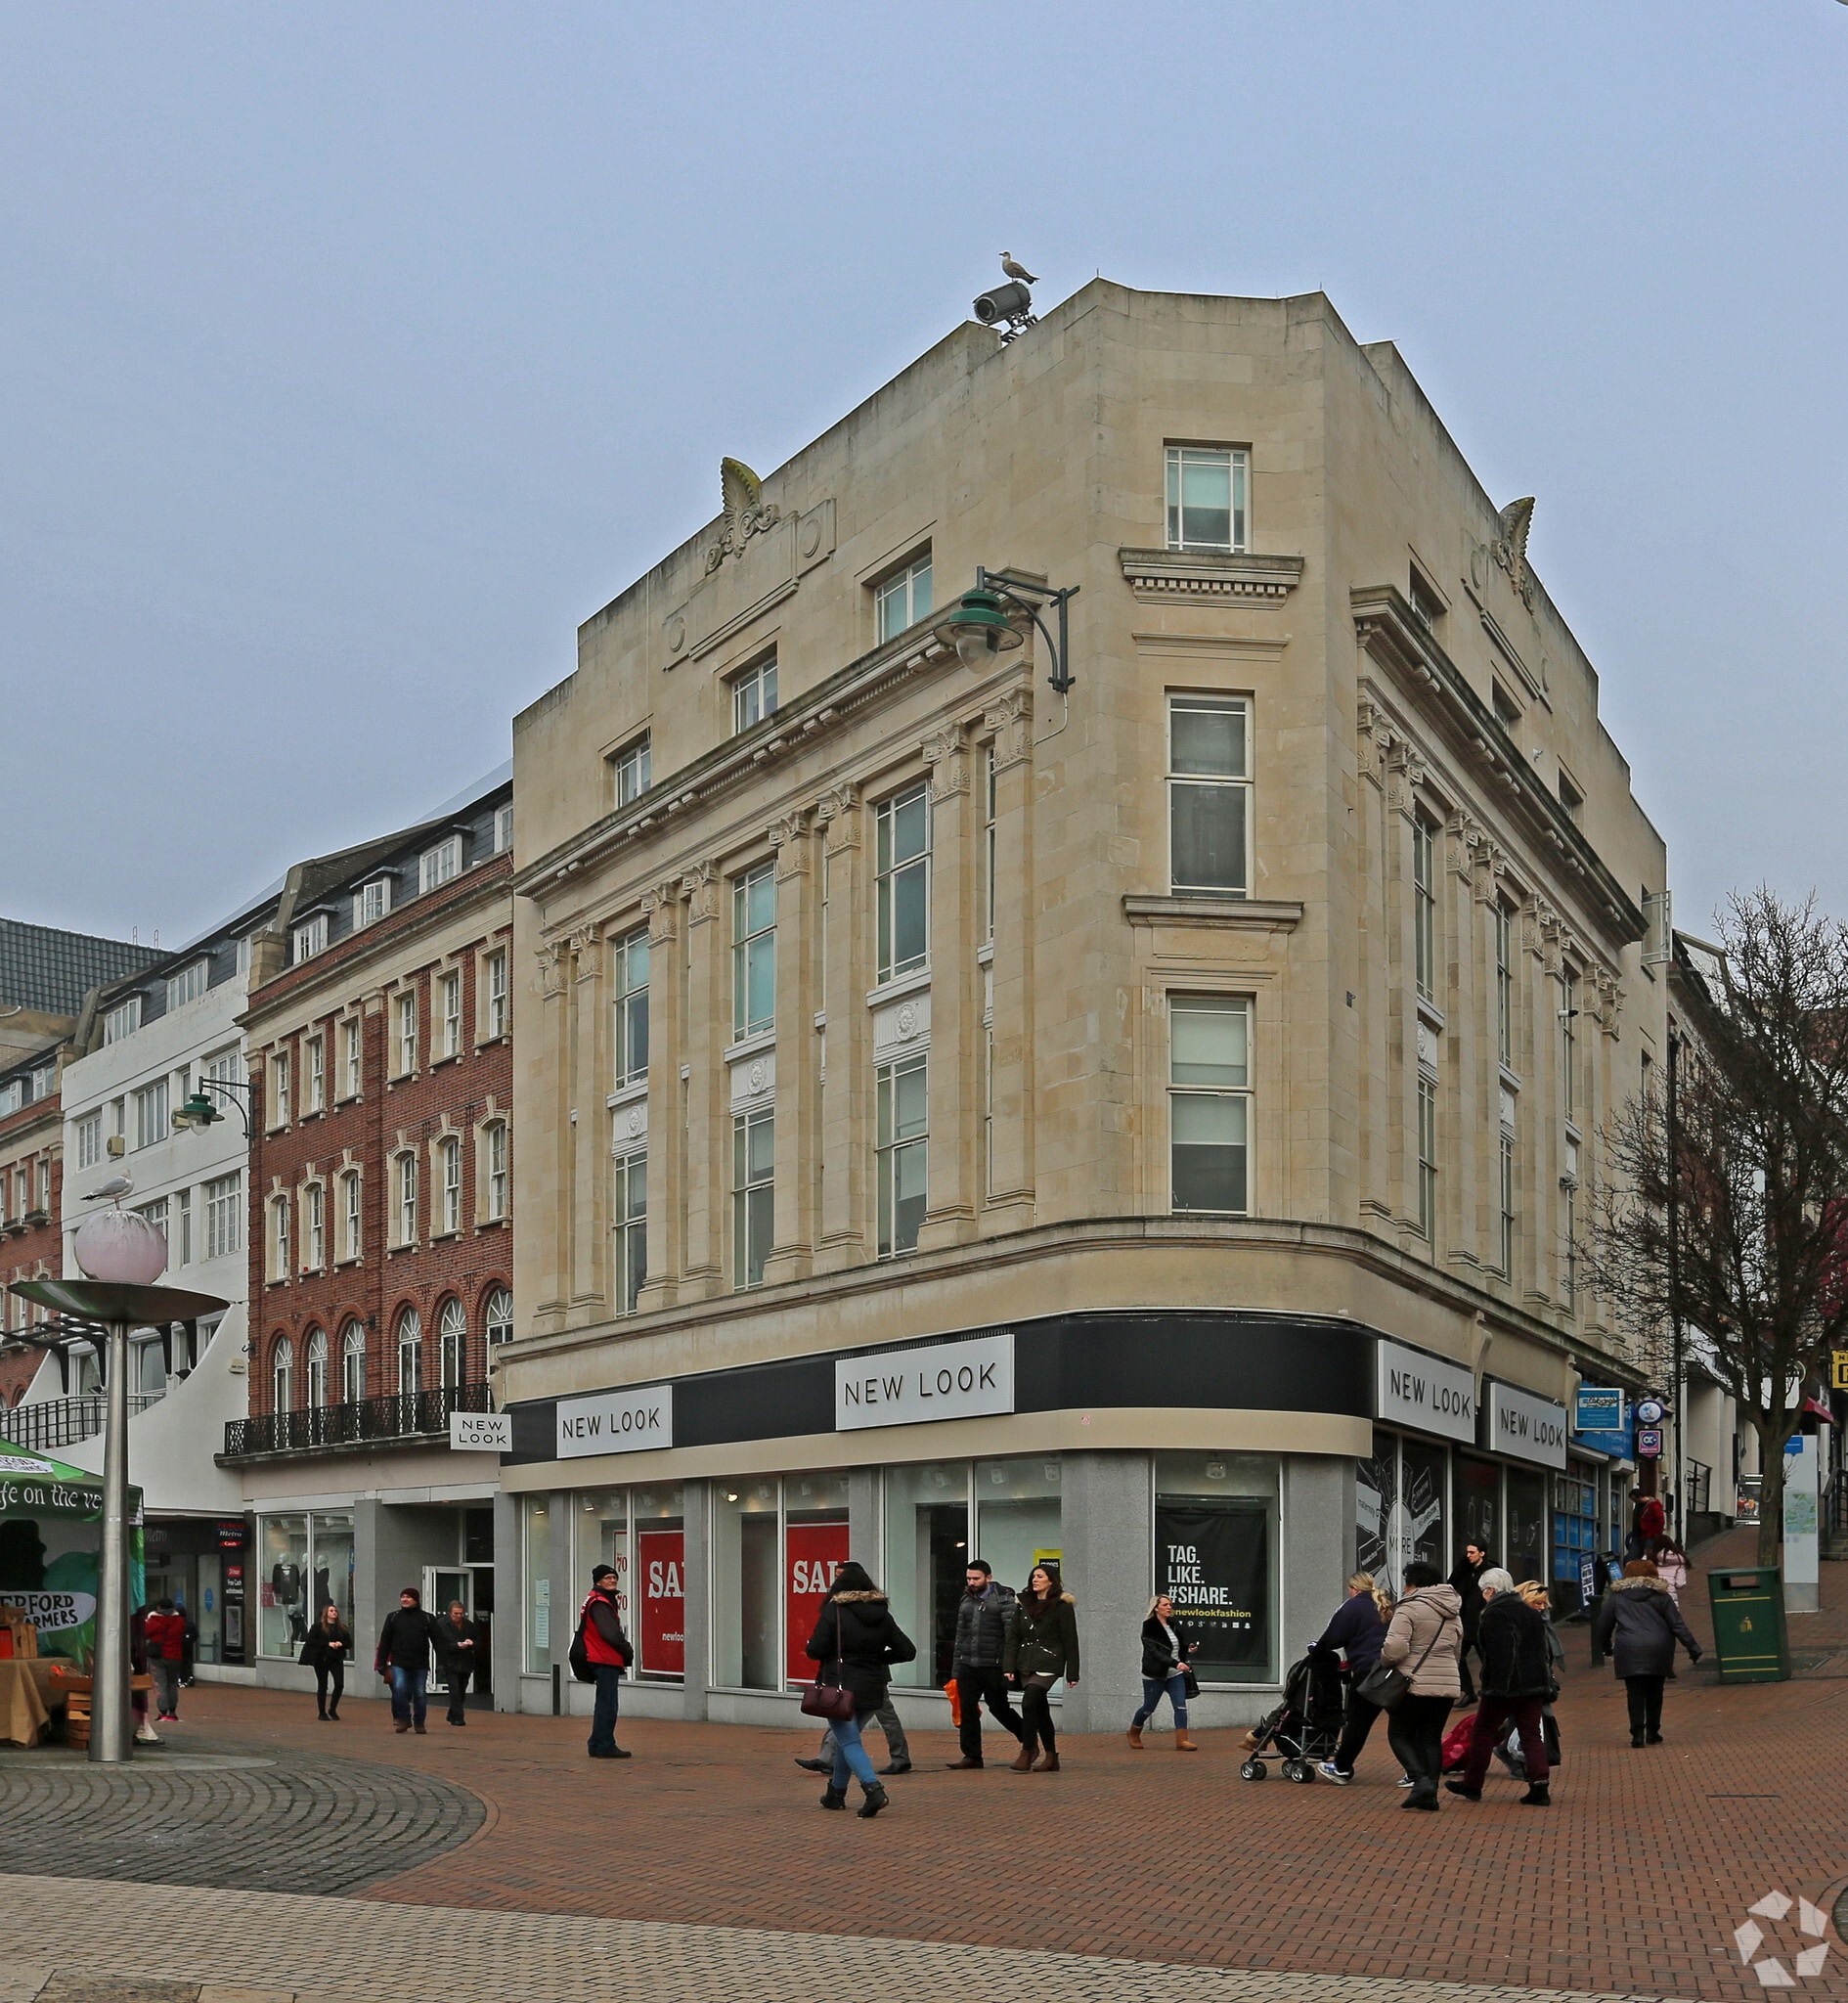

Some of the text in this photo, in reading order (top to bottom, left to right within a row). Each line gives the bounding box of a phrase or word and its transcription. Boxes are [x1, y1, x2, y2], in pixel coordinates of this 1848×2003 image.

[845, 1362, 996, 1405] NEW LOOK
[1390, 1369, 1472, 1418] NEW LOOK
[462, 1420, 503, 1431] NEW
[562, 1407, 660, 1439] NEW LOOK
[1501, 1407, 1564, 1448] NEW LOOK
[459, 1434, 506, 1444] LOOK
[0, 1481, 103, 1510] fe on the ve
[1167, 1545, 1201, 1563] TAG.
[648, 1561, 684, 1598] SA
[793, 1560, 841, 1594] SAL
[1167, 1566, 1205, 1583] LIKE.
[1168, 1586, 1233, 1605] #SHARE.
[23, 1609, 78, 1628] ARMERS
[662, 1631, 684, 1642] newloo
